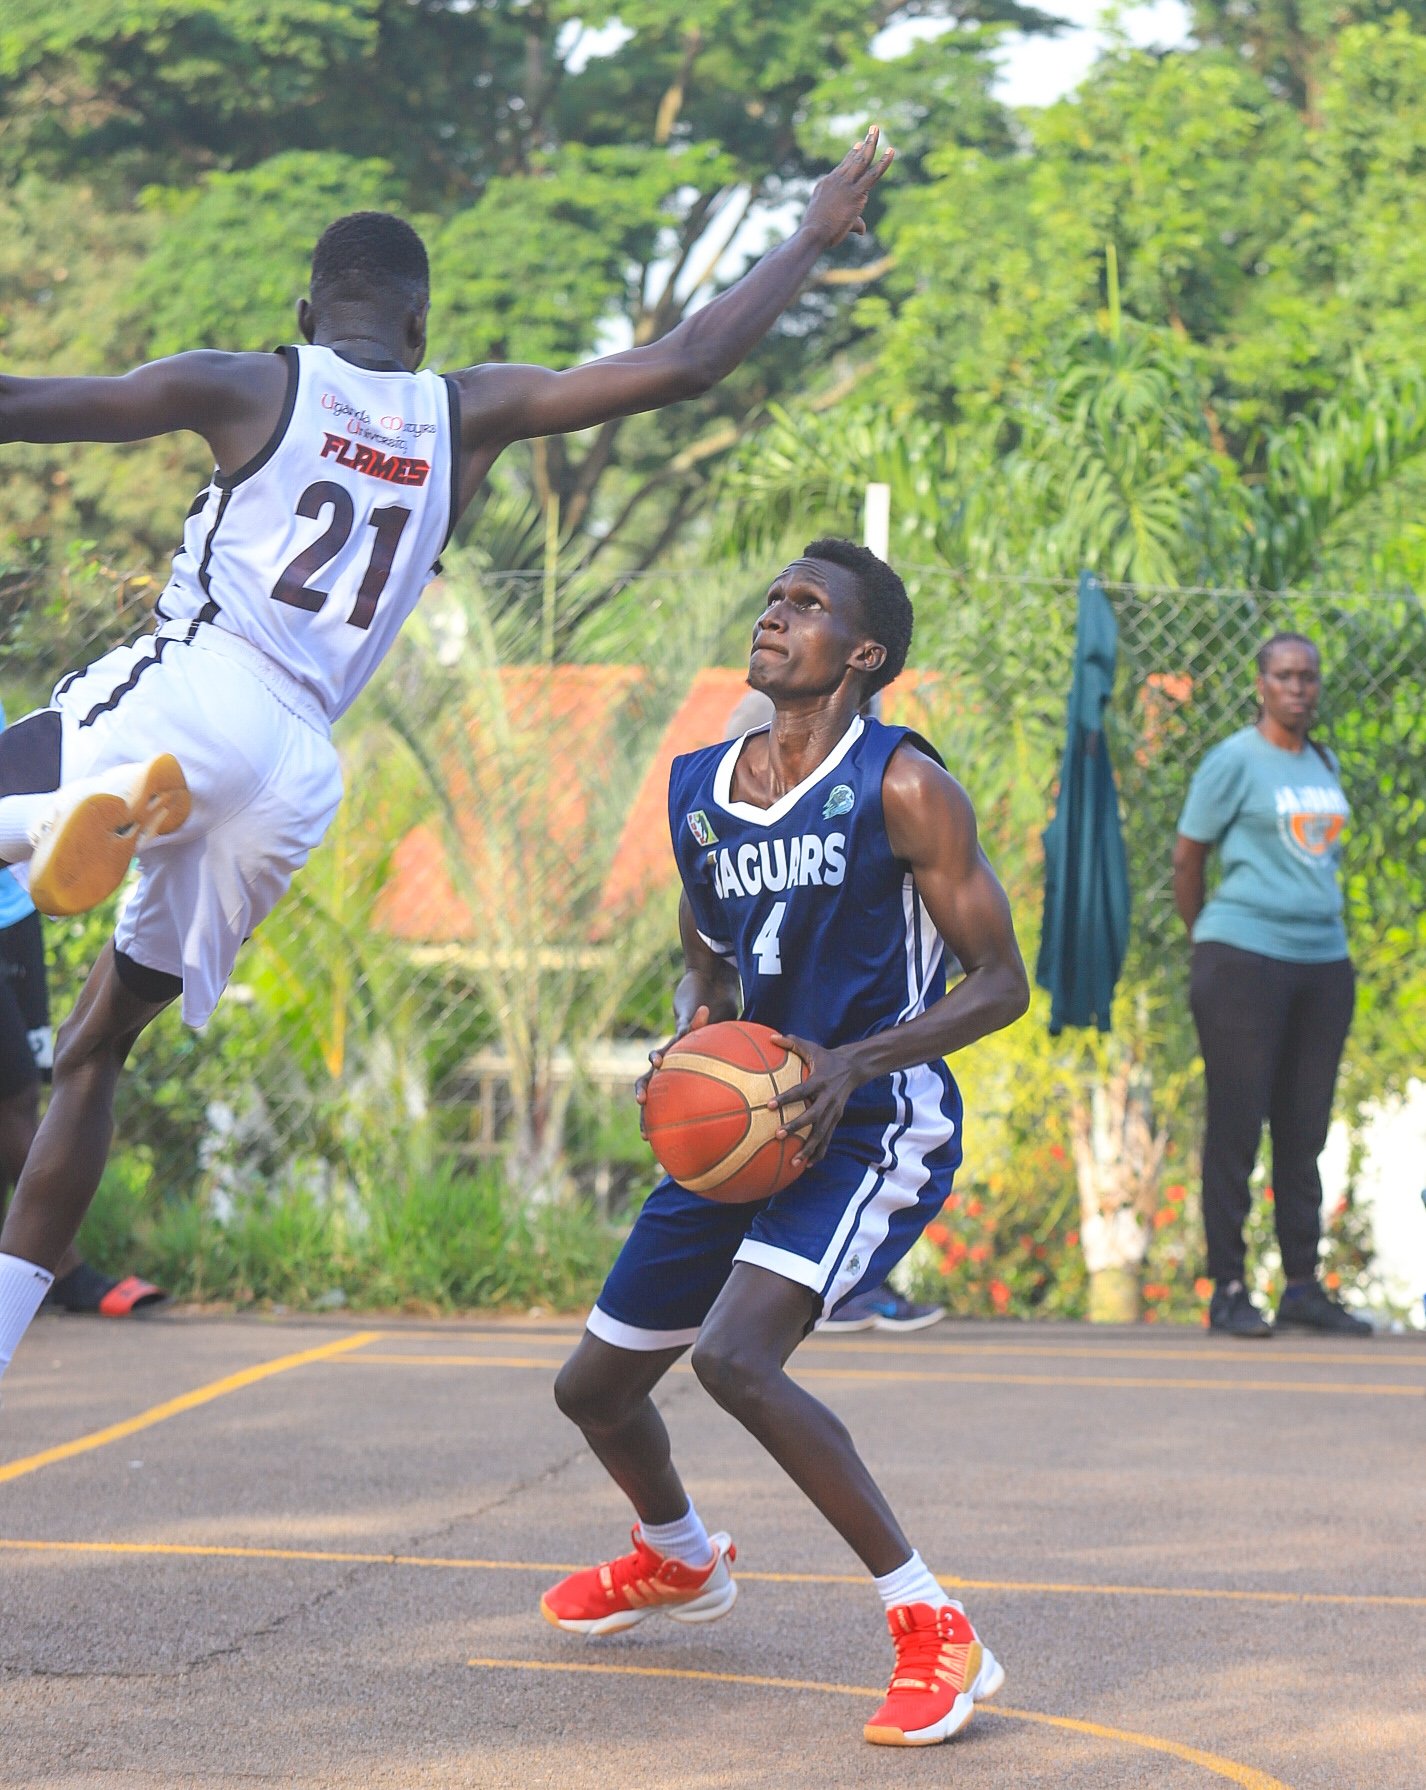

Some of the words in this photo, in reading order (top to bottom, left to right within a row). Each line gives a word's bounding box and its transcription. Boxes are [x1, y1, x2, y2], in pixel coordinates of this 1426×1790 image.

[321, 393, 371, 424] Uganda
[319, 432, 432, 487] FLAMES
[347, 418, 408, 455] University
[270, 480, 413, 631] 21
[752, 901, 787, 975] 4
